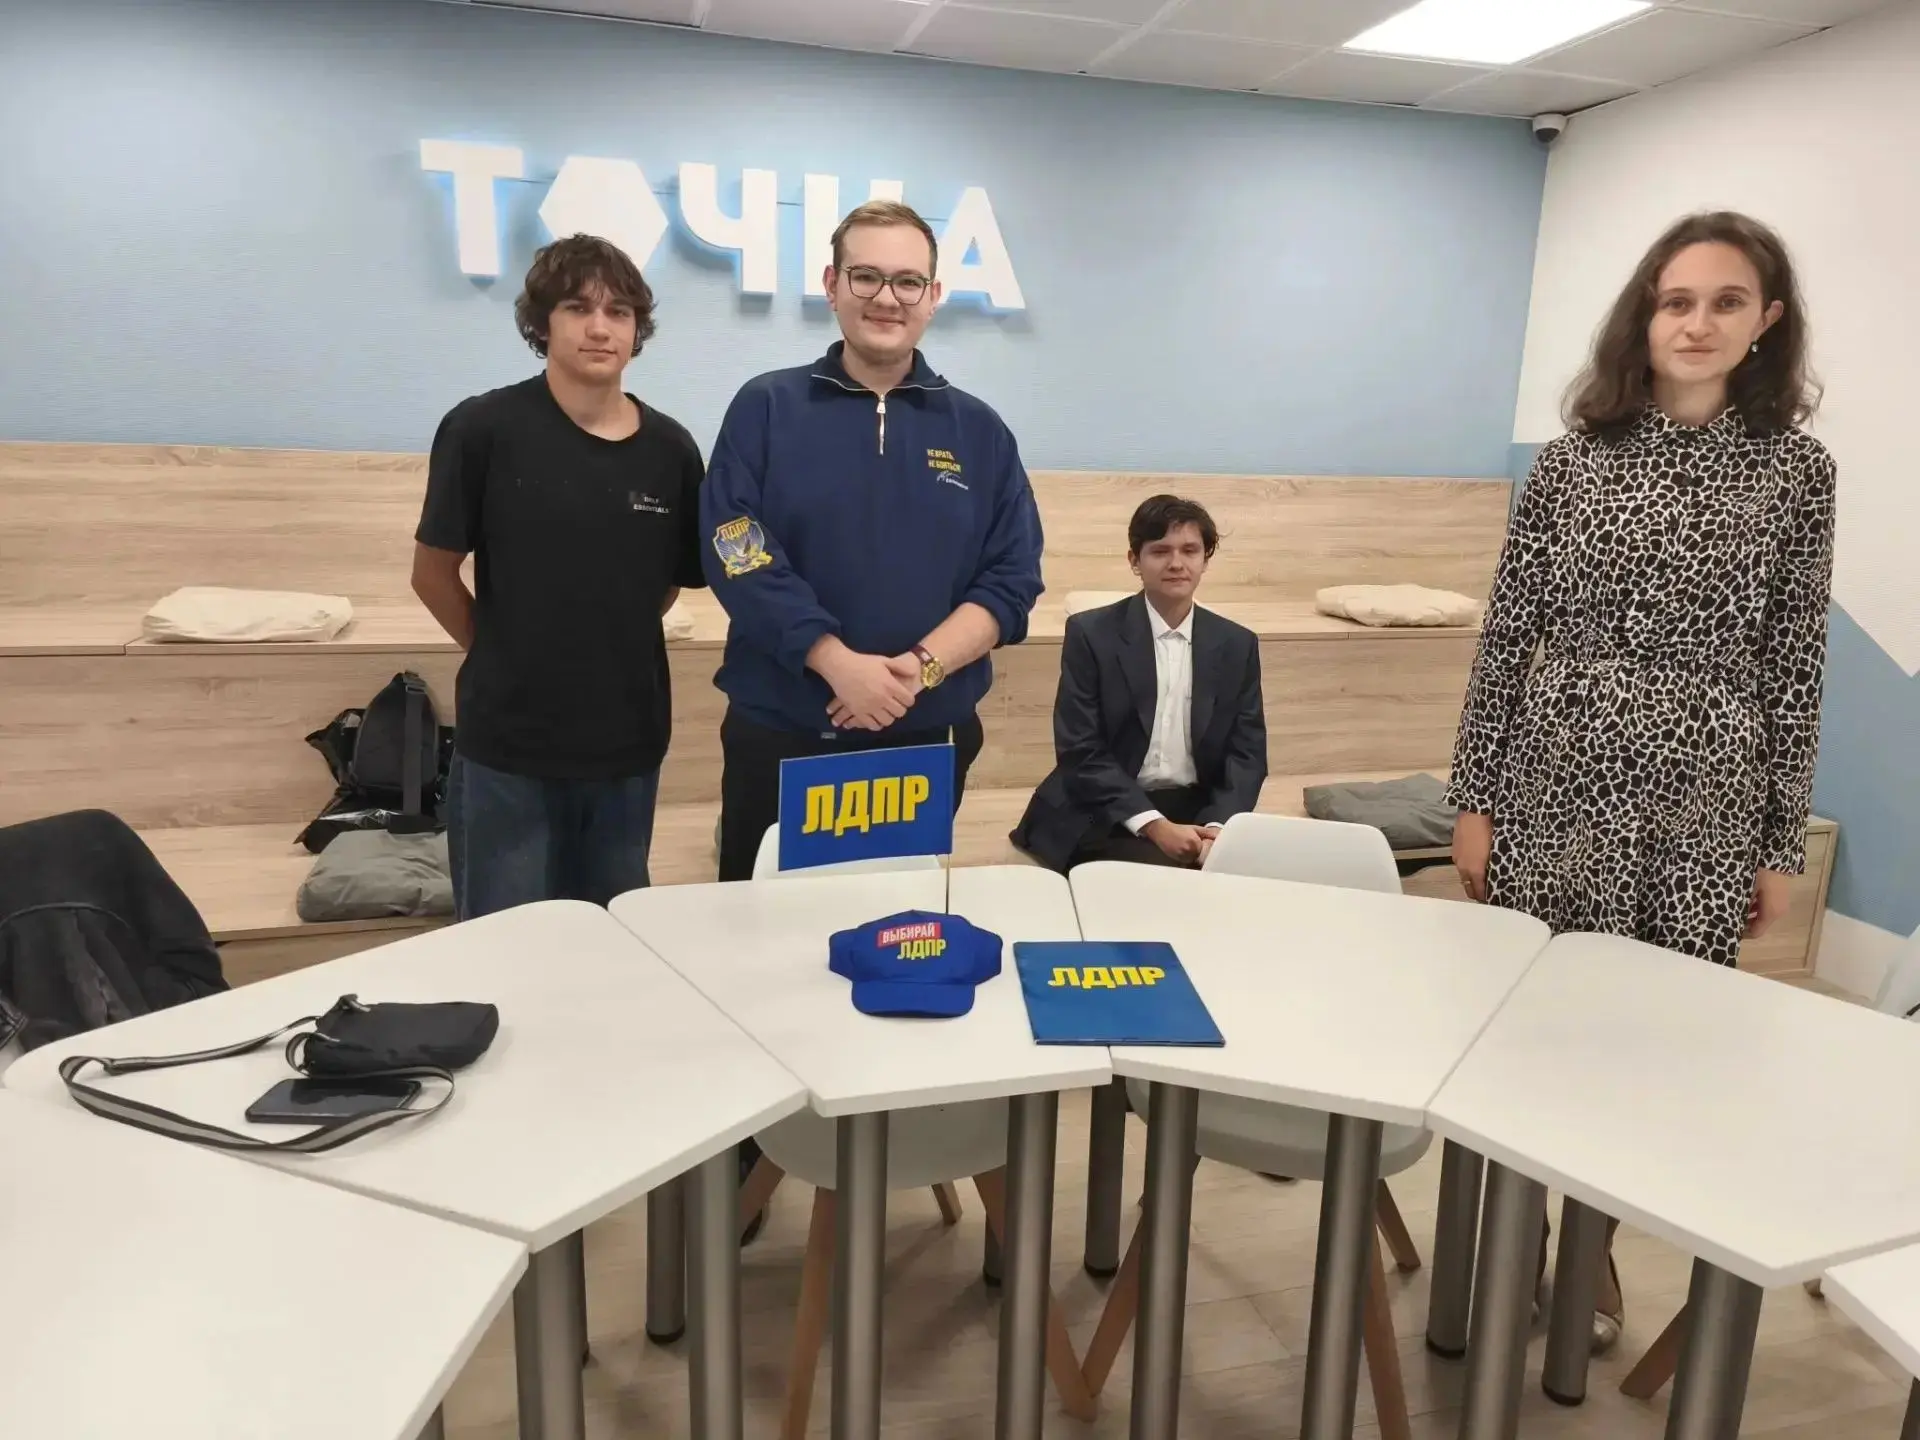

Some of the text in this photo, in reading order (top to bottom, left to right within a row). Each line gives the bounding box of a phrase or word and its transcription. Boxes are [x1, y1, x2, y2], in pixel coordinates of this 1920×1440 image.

[720, 519, 750, 540] ЛДПР
[802, 775, 930, 837] ЛДПР
[882, 922, 936, 944] ВЫБИРАЙ
[897, 938, 946, 960] ЛДПР
[1047, 967, 1166, 989] ЛДПР
